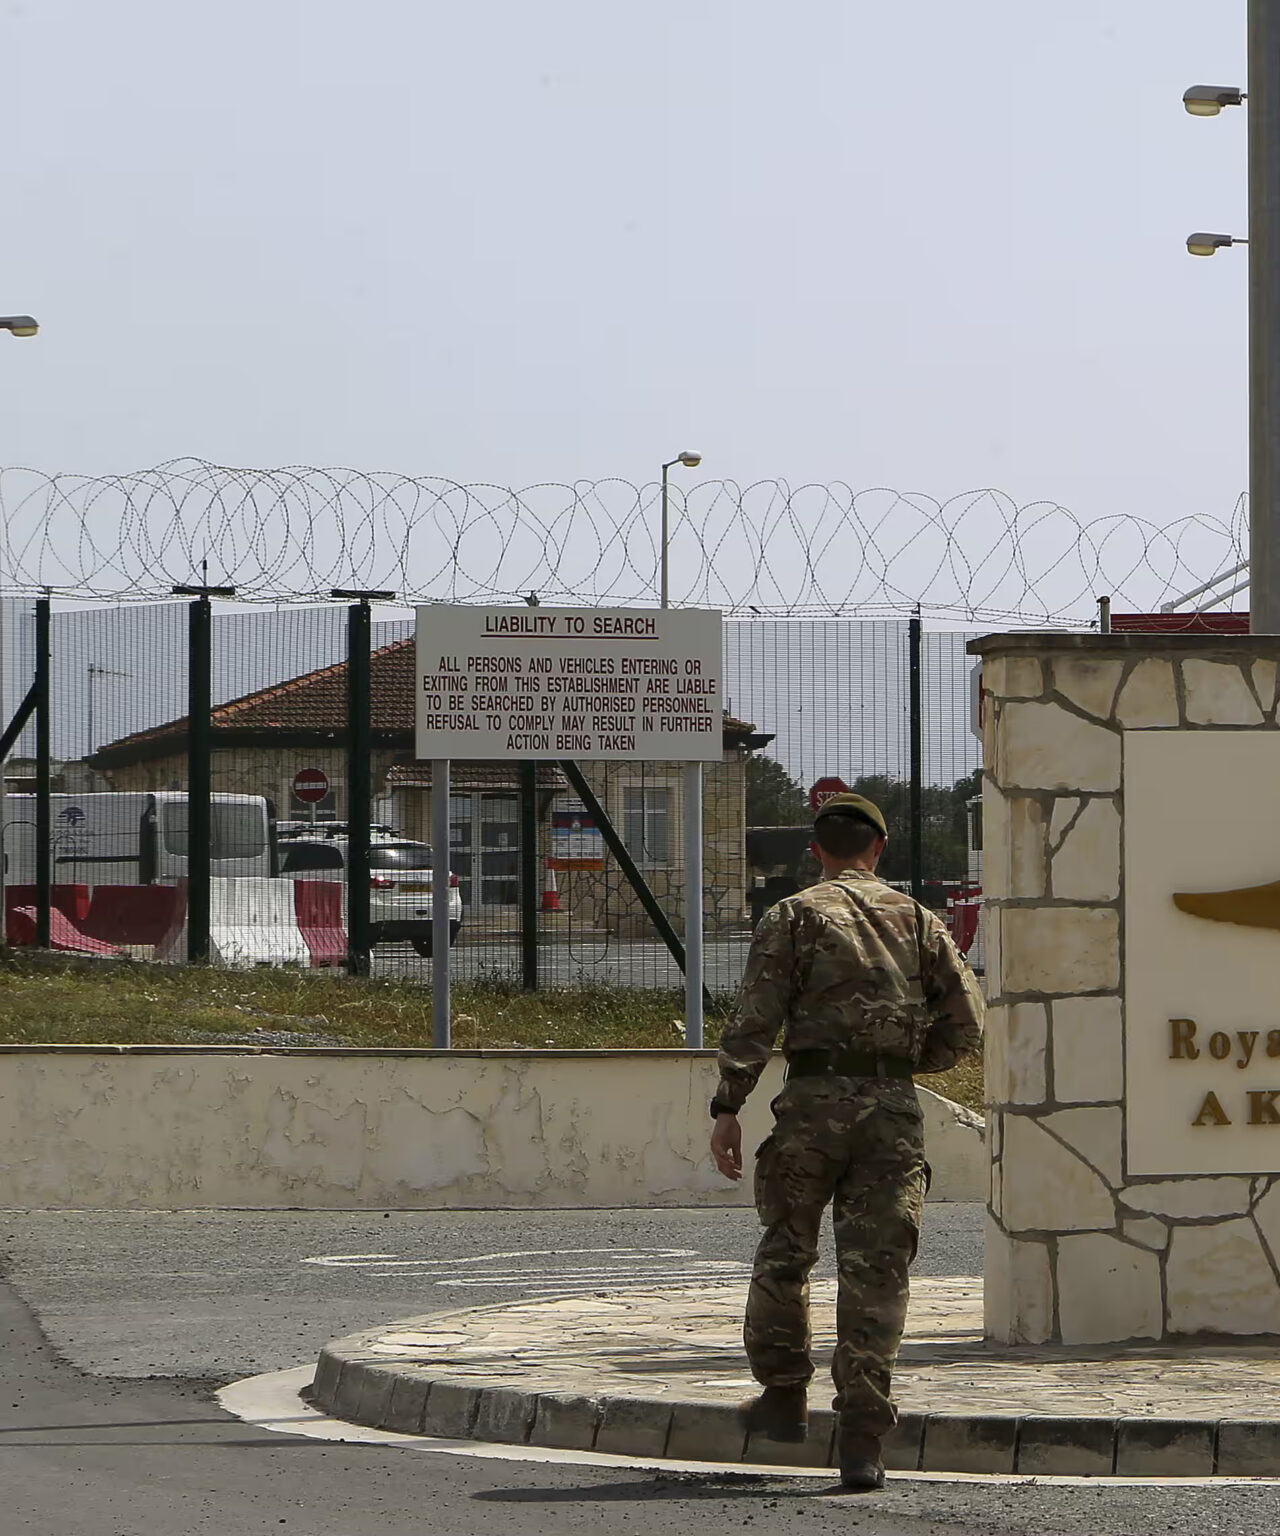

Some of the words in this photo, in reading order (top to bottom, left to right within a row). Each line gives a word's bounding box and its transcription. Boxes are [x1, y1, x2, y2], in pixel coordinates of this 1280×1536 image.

[486, 616, 556, 633] LIABILITY
[565, 617, 584, 633] TO
[593, 618, 655, 634] SEARCH
[438, 655, 461, 673] ALL
[467, 656, 523, 673] PERSONS
[528, 656, 553, 673] AND
[559, 657, 615, 674] VEHICLES
[621, 658, 678, 675] ENTERING
[684, 658, 702, 675] OR
[423, 675, 468, 692] EXITING
[474, 676, 508, 692] FROM
[514, 676, 540, 693] THIS
[547, 676, 640, 694] ESTABLISHMENT
[645, 677, 670, 695] ARE
[676, 678, 716, 695] LIABLE
[426, 694, 442, 711] TO
[449, 694, 465, 712] BE
[471, 695, 534, 713] SEARCHED
[540, 695, 556, 713] BY
[562, 696, 636, 713] AUTHORISED
[642, 696, 714, 714] PERSONNEL.
[426, 714, 480, 731] REFUSAL
[486, 714, 502, 731] TO
[508, 714, 555, 732] COMPLY
[561, 715, 586, 732] MAY
[592, 715, 636, 733] RESULT
[642, 716, 653, 733] IN
[660, 716, 713, 733] FURTHER
[506, 733, 549, 751] ACTION
[556, 734, 592, 751] BEING
[598, 734, 636, 751] TAKEN
